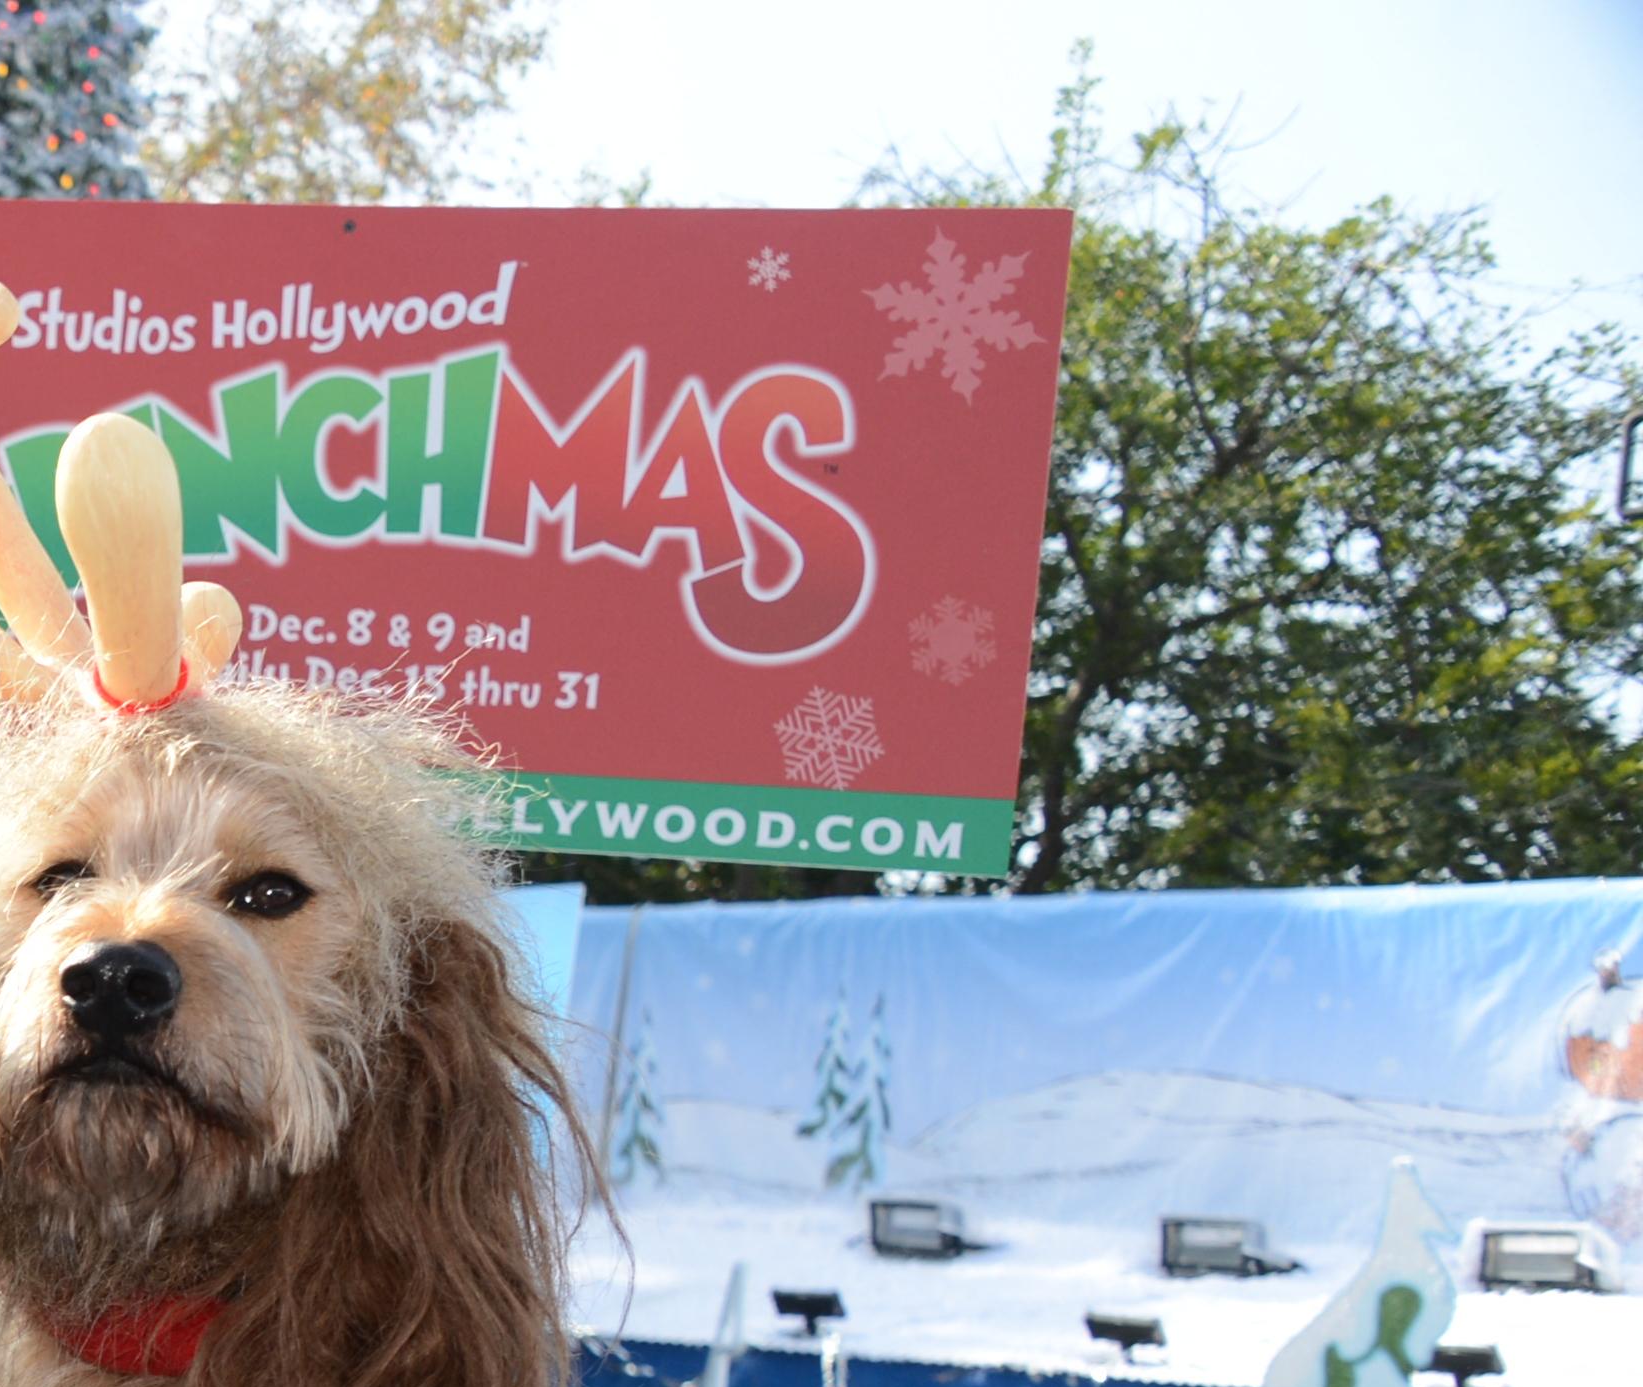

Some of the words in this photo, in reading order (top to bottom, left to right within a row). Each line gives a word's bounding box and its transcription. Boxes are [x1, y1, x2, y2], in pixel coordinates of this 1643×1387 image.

[12, 286, 198, 355] Studios
[211, 259, 519, 354] Hollywood
[248, 603, 338, 645] Dec.
[347, 606, 377, 647] 8
[387, 613, 412, 649] &
[426, 612, 455, 653] 9
[463, 613, 532, 654] and
[459, 664, 542, 709] thru
[554, 670, 601, 710] 31
